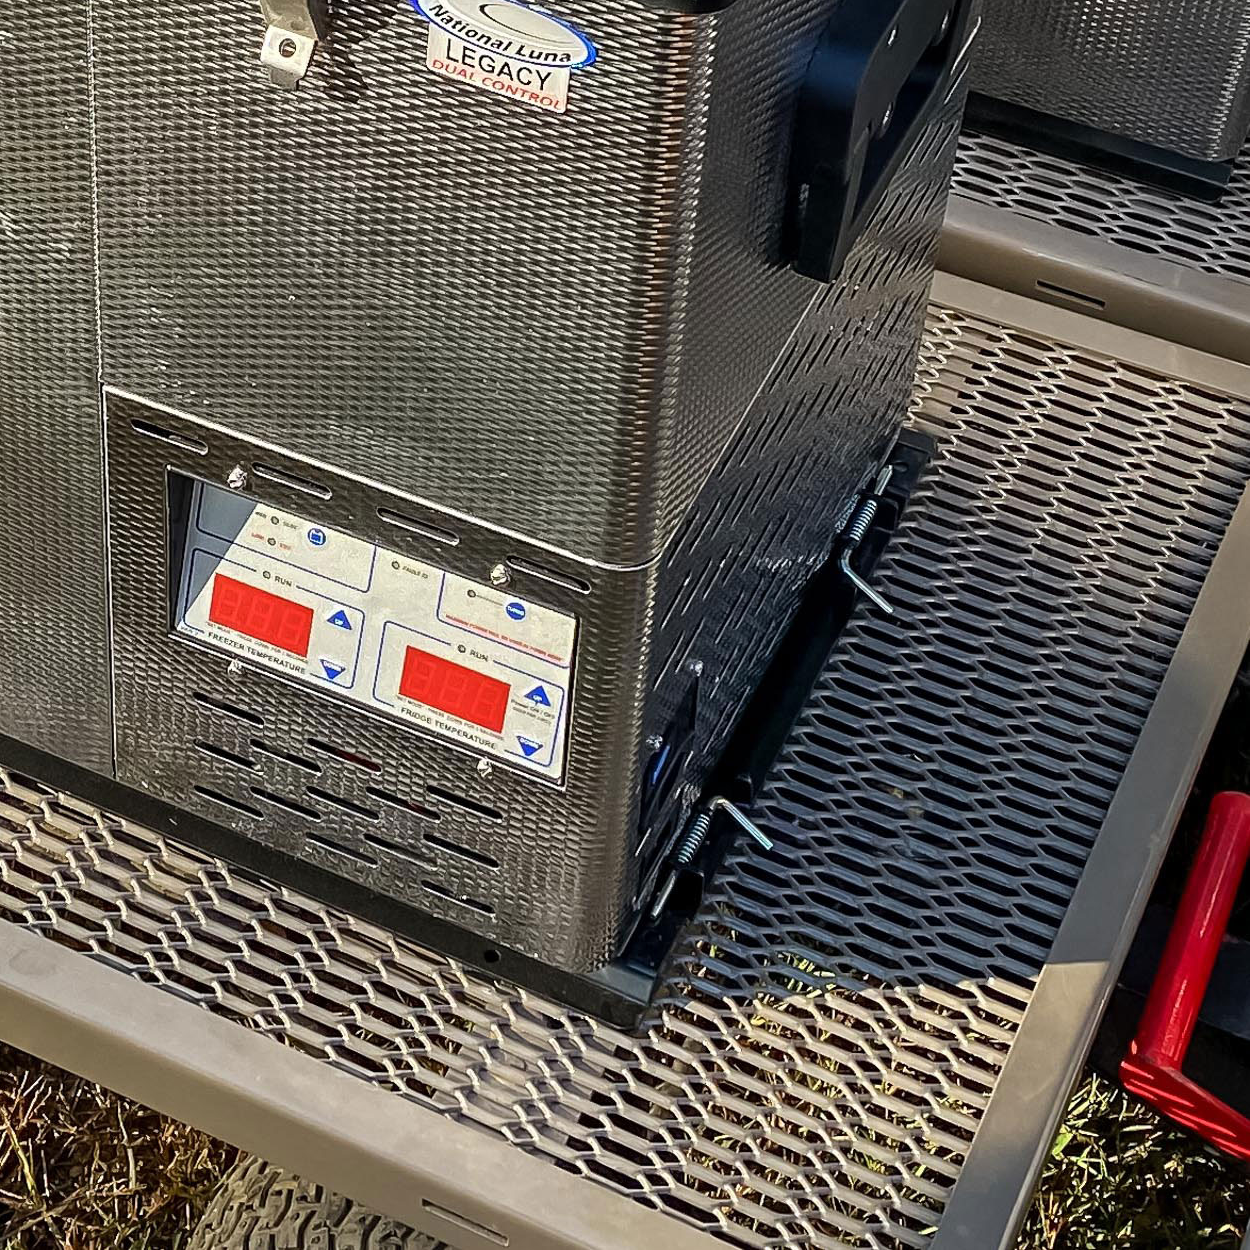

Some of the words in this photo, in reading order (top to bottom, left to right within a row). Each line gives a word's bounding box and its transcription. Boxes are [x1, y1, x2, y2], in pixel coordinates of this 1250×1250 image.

[429, 3, 513, 52] National
[514, 43, 572, 64] Luna
[432, 58, 477, 83] DUAL
[482, 76, 563, 111] CONTROL
[446, 38, 553, 92] LEGACY
[274, 575, 293, 587] RUN
[208, 631, 245, 651] FREEZER
[246, 645, 306, 675] TEMPERATURE
[470, 649, 489, 663] RUN
[400, 707, 432, 725] FRIDGE
[434, 719, 496, 749] TEMPERATURE
